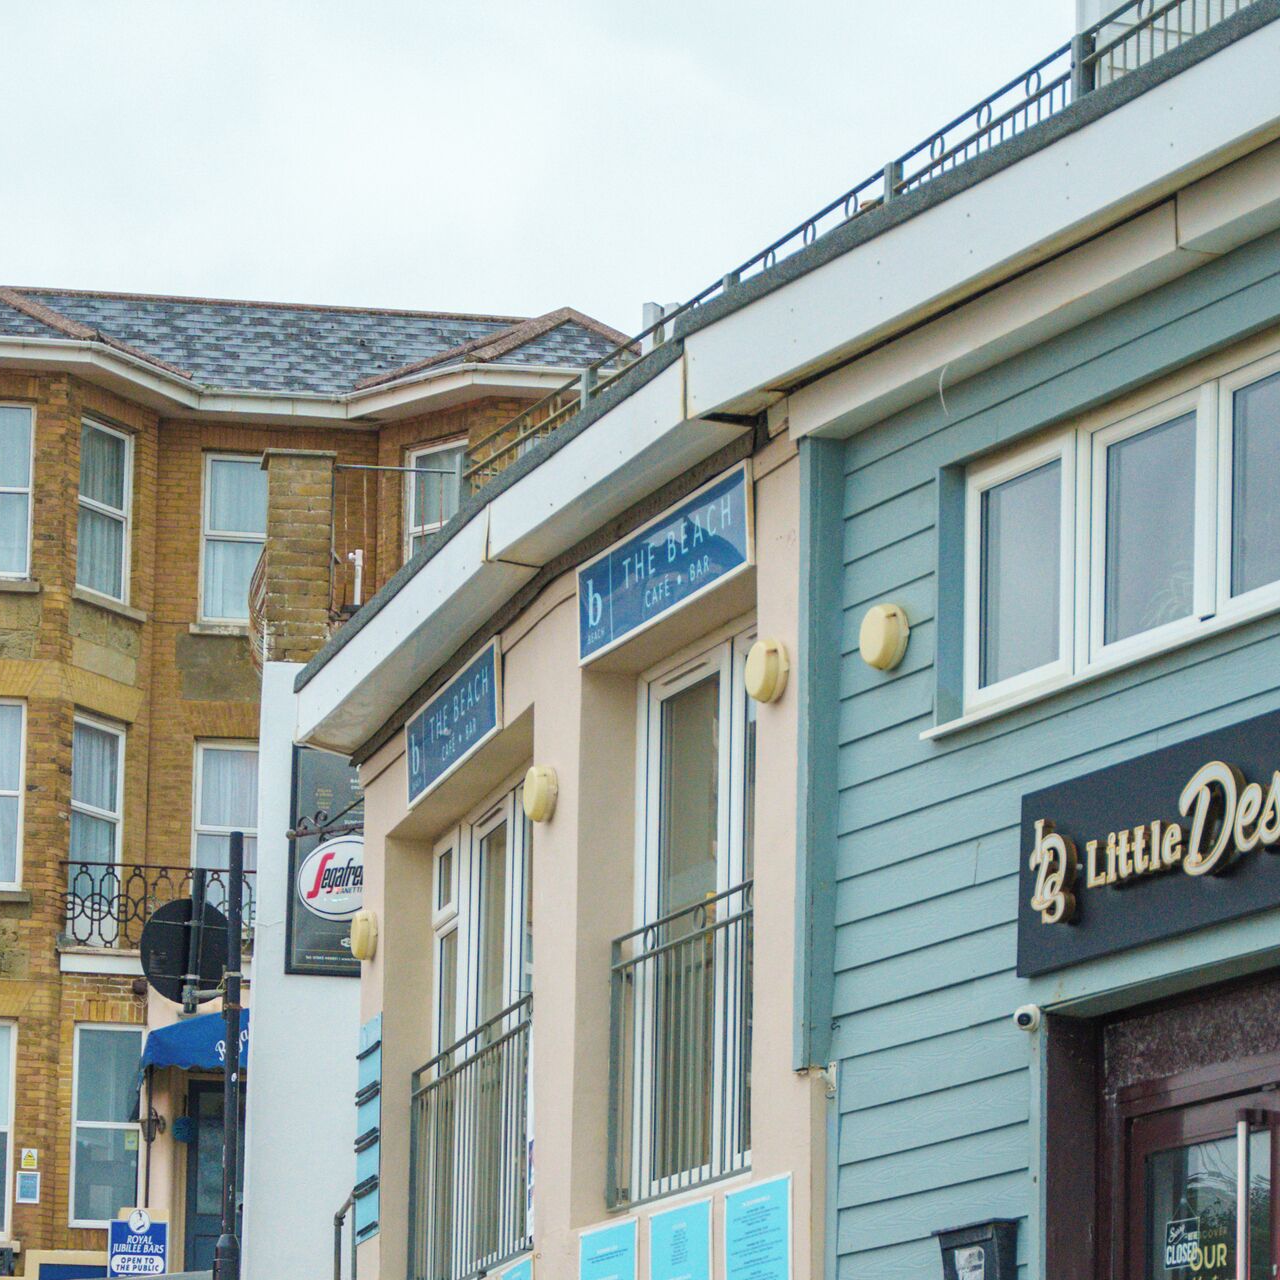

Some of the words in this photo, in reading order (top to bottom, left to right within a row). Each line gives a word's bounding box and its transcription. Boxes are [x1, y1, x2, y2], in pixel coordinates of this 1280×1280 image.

[623, 543, 656, 589] THE
[667, 494, 731, 563] BEACH
[645, 574, 671, 608] CAFÉ
[689, 555, 710, 582] BAR
[429, 704, 449, 744] THE
[453, 665, 488, 723] BEACH
[465, 717, 476, 741] BAR
[1086, 820, 1183, 889] Little
[111, 1243, 142, 1254] JUBILEE
[143, 1244, 165, 1254] BARS
[126, 1234, 153, 1245] ROYAL
[120, 1256, 143, 1264] OPEN
[144, 1257, 155, 1265] TO
[1165, 1241, 1199, 1265] CLOSED
[1188, 1243, 1228, 1272] OUR
[132, 1264, 160, 1272] PUBLIC
